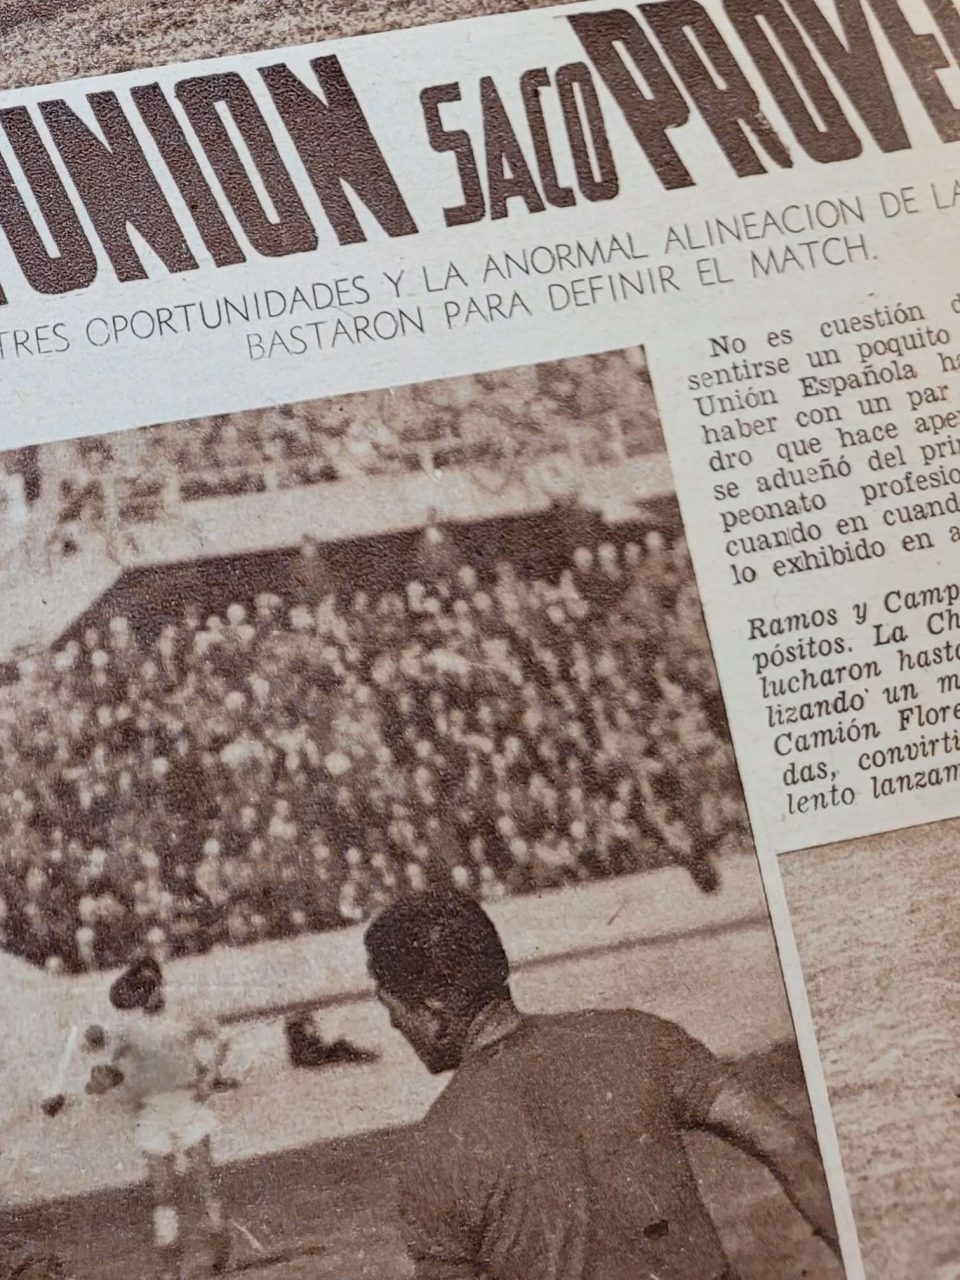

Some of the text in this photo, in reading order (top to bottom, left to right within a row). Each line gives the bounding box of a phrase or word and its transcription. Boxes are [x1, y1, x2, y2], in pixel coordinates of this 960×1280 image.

[419, 61, 619, 228] SACO
[86, 275, 370, 347] OPORTUNIDADES
[383, 270, 405, 298] Y
[422, 261, 468, 292] LA
[483, 232, 649, 283] ANORMAL
[664, 196, 865, 254] ALINEACION
[879, 186, 920, 218] DE
[246, 234, 878, 360] BASTARON PARA DEFINIR EL MATCH.
[708, 336, 746, 357] No
[767, 329, 794, 347] es
[820, 303, 926, 338] cuestión
[688, 327, 950, 390] sentirse un poquito
[693, 387, 779, 416] Unión
[798, 360, 918, 397] Española
[701, 385, 949, 445] haber con un par
[708, 410, 960, 472] dro que hace ape
[713, 435, 960, 501] se adueñó del pri
[719, 492, 827, 533] peonato
[725, 522, 822, 557] cuando
[836, 516, 869, 535] en
[730, 564, 757, 585] lo
[772, 538, 886, 577] exhibido
[901, 533, 935, 552] en
[747, 608, 838, 640] Ramos
[853, 602, 867, 625] y
[752, 637, 852, 675] pósitos.
[872, 624, 909, 647] La
[759, 661, 882, 699] lucharon
[882, 683, 918, 704] un
[774, 722, 881, 756] Camión
[783, 762, 836, 786] das,
[787, 784, 855, 815] lento
